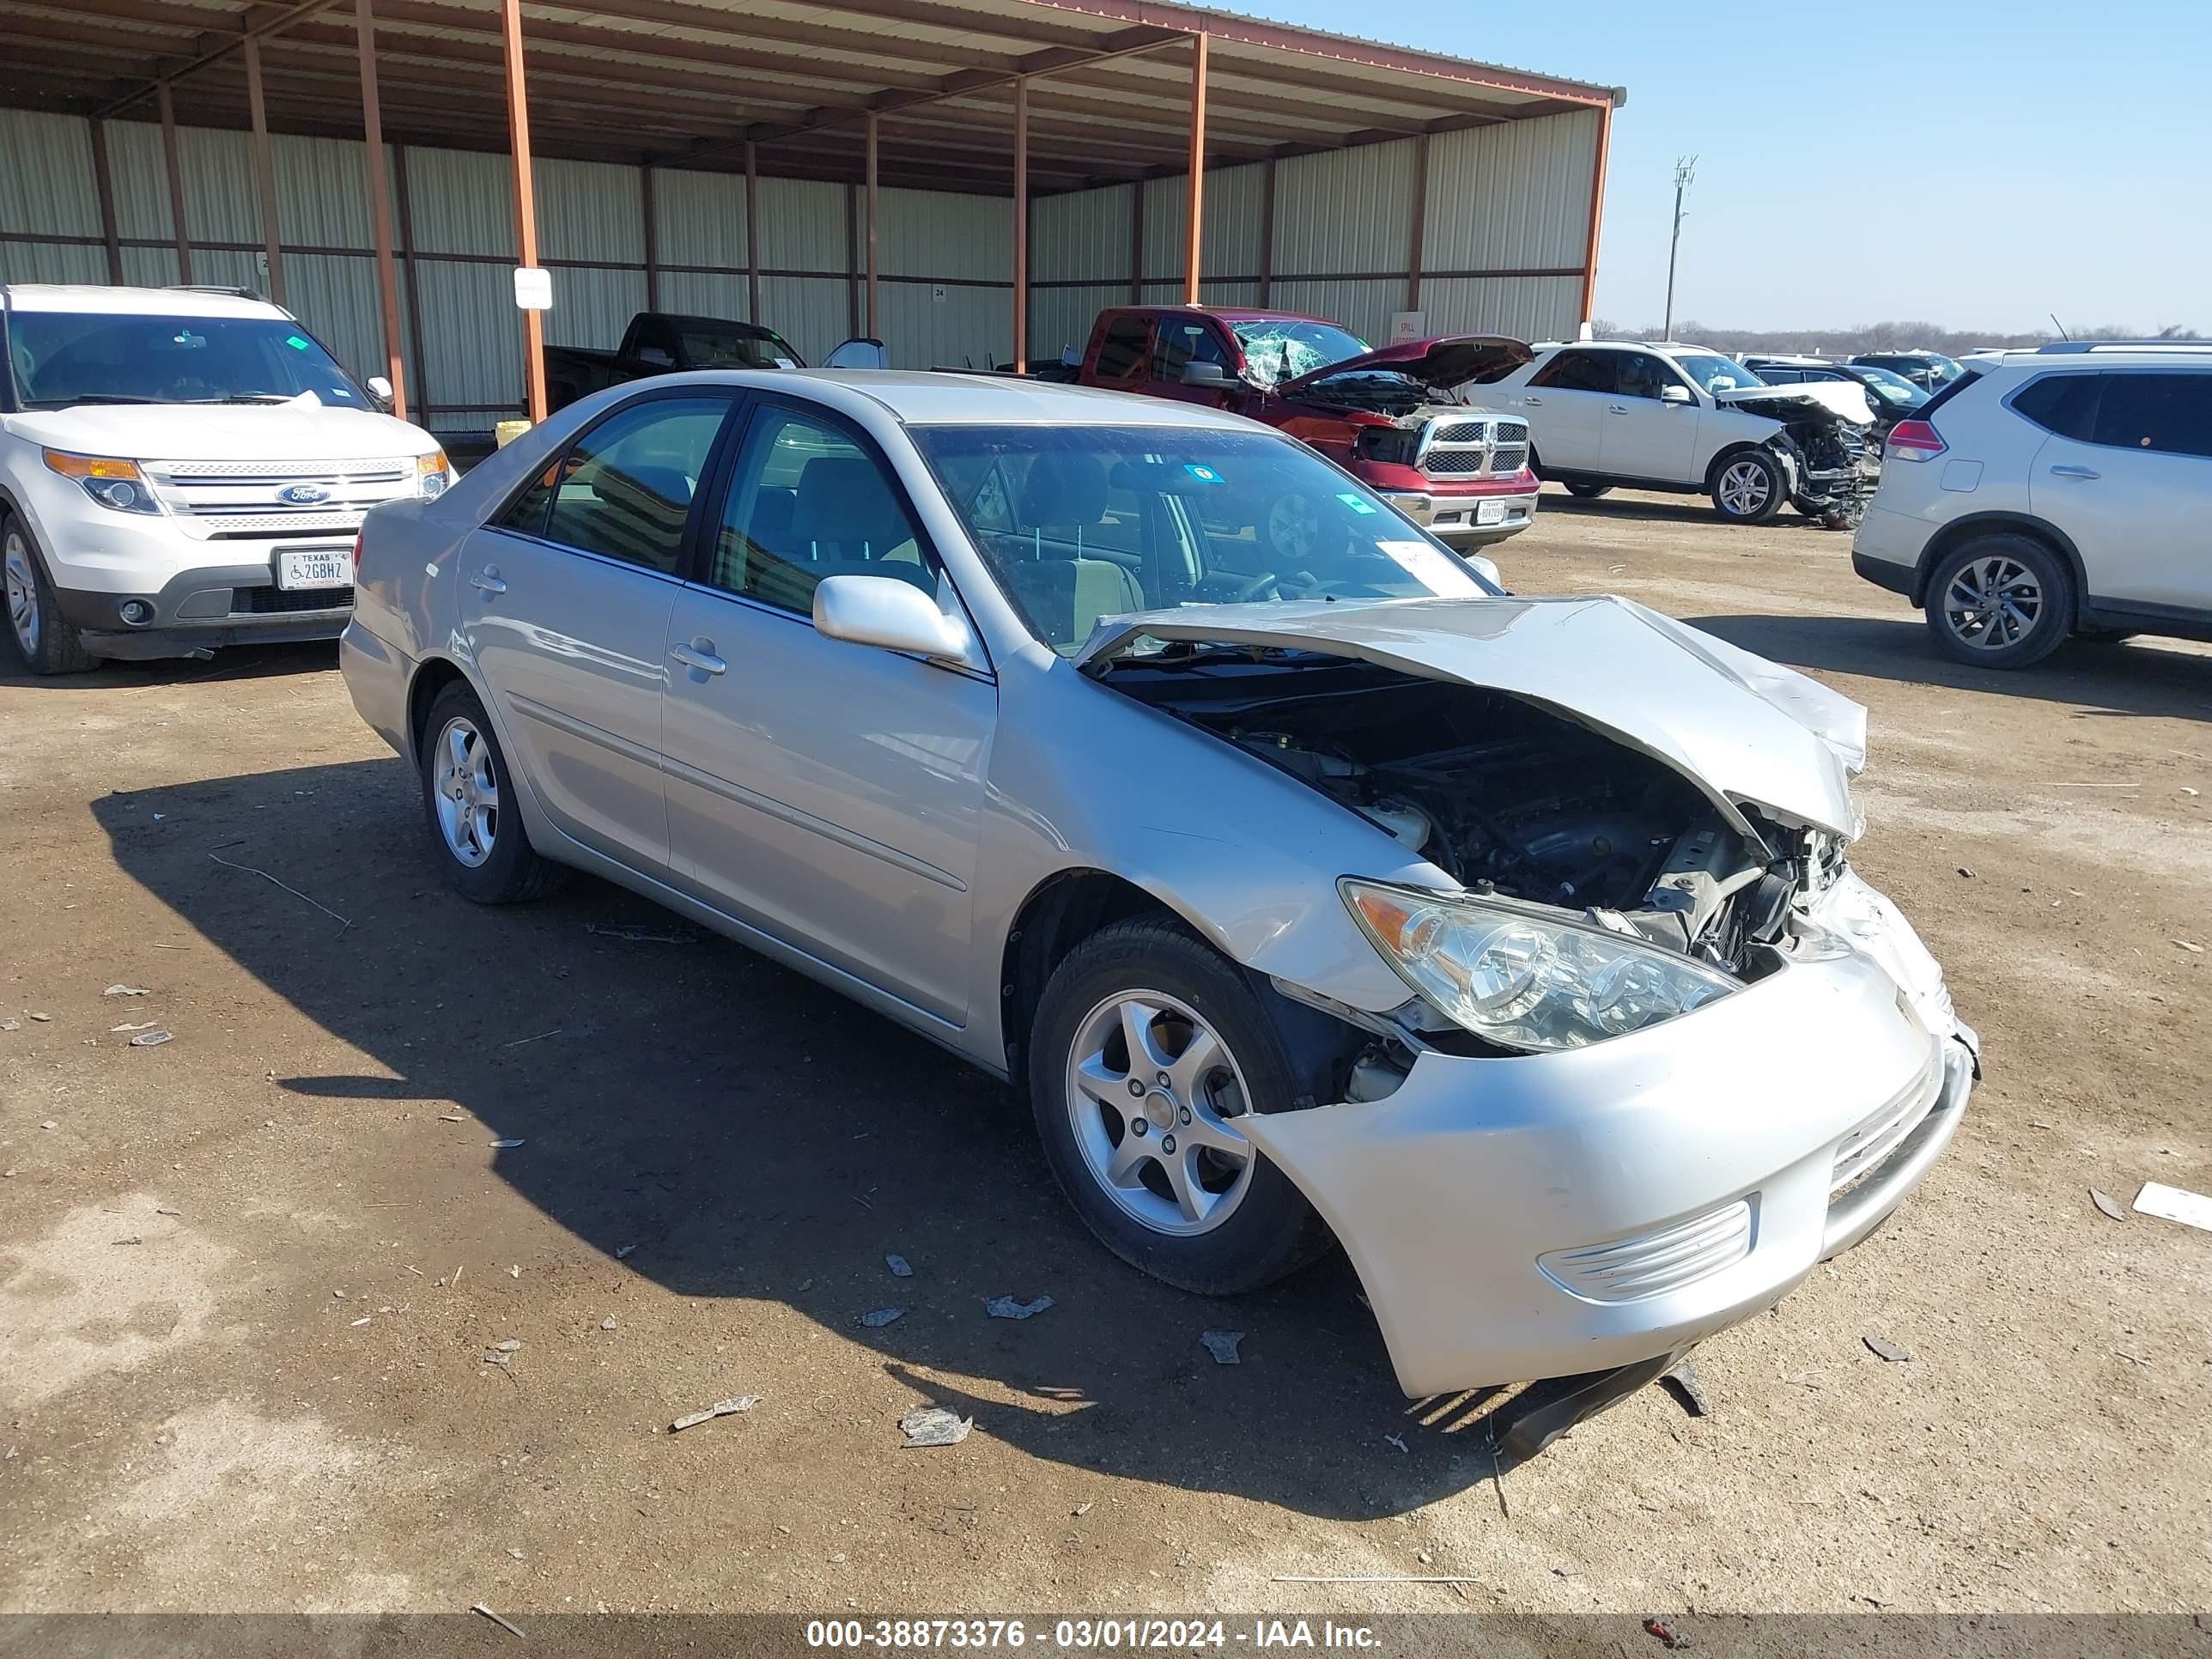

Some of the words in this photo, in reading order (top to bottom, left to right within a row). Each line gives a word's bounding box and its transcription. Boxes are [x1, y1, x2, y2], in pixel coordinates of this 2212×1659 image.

[1401, 322, 1415, 332] SPILL
[291, 487, 319, 500] Ford
[301, 554, 331, 562] TEXAS
[305, 562, 343, 580] 2GBHZ
